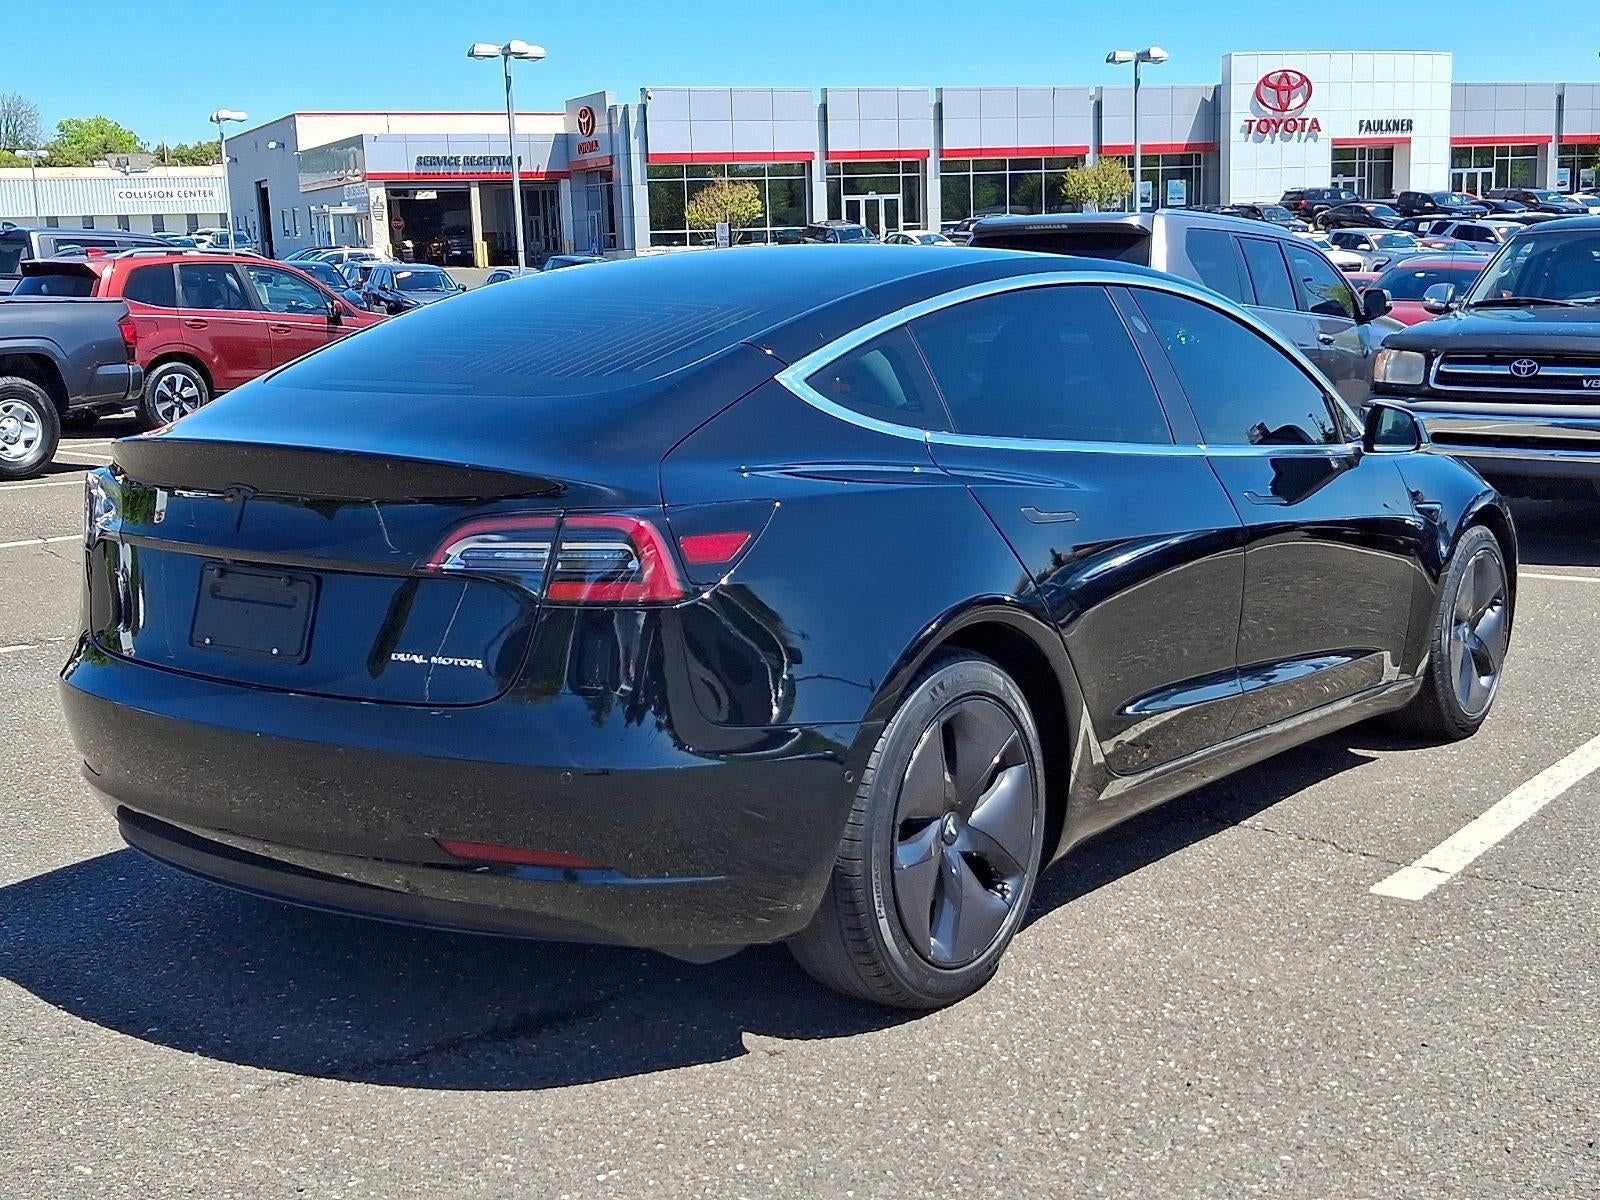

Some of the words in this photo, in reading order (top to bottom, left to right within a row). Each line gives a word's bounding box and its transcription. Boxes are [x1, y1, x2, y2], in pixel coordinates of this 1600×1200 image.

[1244, 118, 1321, 134] TOYOTA
[1358, 119, 1413, 133] FAULKNER
[416, 155, 461, 167] SERVICE
[118, 190, 173, 200] COLLISION
[177, 189, 215, 199] CENTER
[1582, 379, 1600, 388] V8
[390, 652, 428, 664] DUAL
[430, 656, 483, 669] MOTOR
